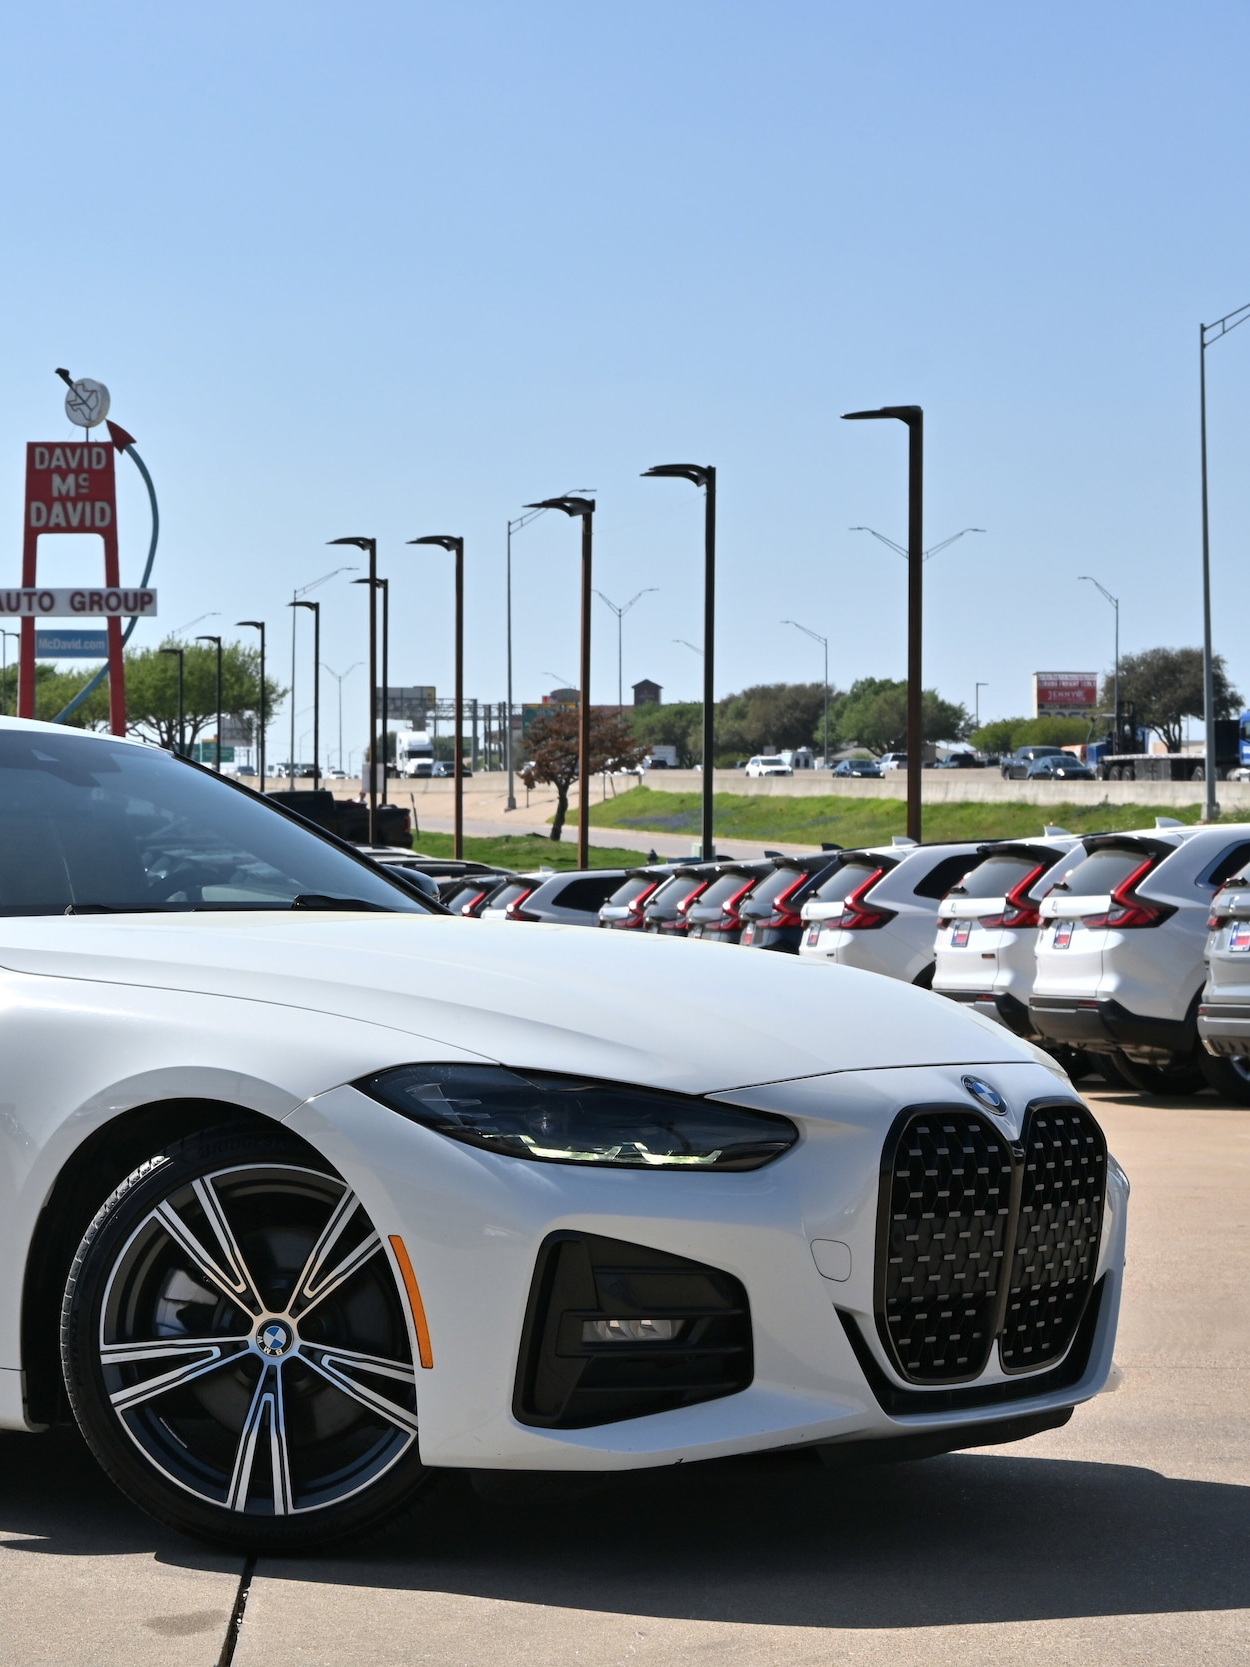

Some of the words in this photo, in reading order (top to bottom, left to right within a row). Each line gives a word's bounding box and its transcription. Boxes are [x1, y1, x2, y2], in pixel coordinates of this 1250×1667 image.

[34, 446, 107, 470] DAVID
[30, 501, 112, 528] DAVID
[69, 591, 154, 613] GROUP
[38, 637, 106, 651] McDavid.com
[257, 1335, 284, 1356] BMW
